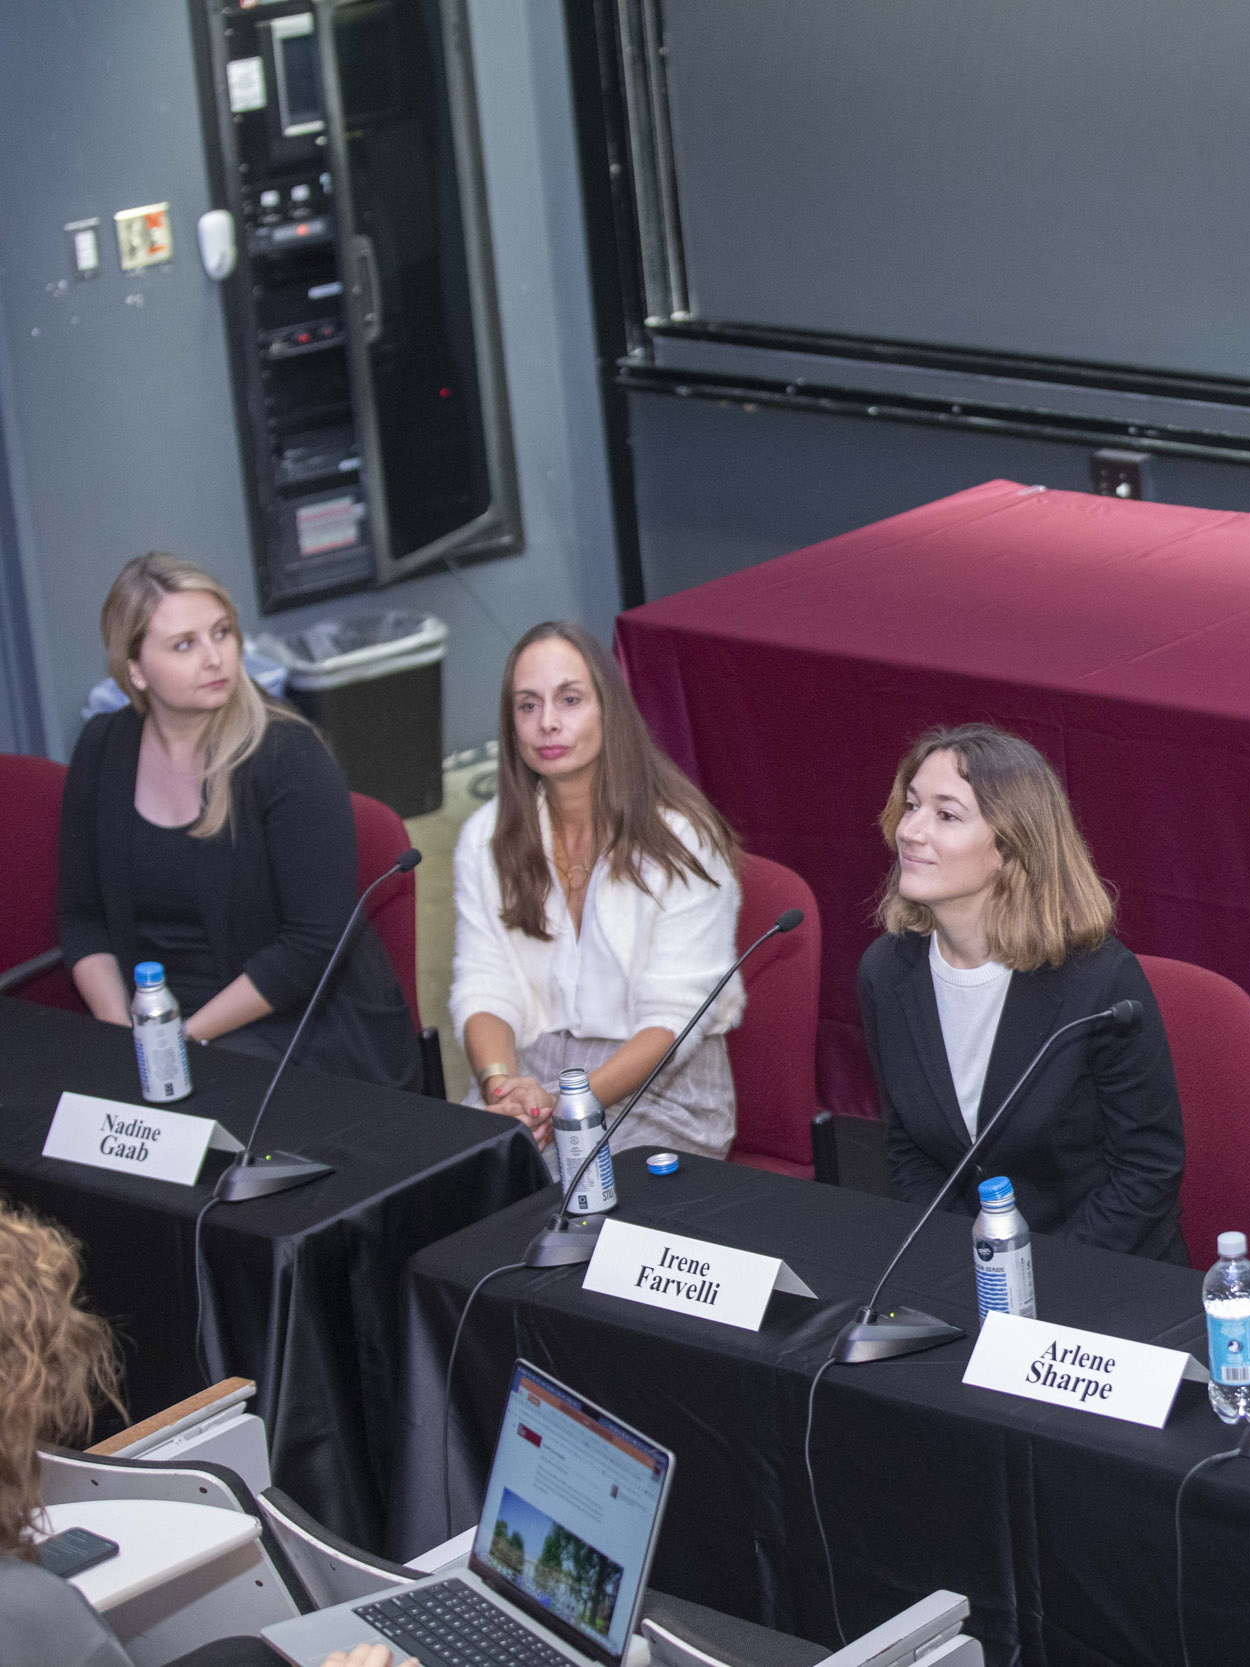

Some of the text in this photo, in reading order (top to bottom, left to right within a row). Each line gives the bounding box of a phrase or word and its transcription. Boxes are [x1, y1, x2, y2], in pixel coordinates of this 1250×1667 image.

[101, 1114, 161, 1142] Nadine
[99, 1134, 149, 1163] Gaab
[659, 1245, 711, 1279] Irene
[633, 1265, 720, 1306] Farvelli
[1040, 1341, 1115, 1374] Arlene
[1025, 1360, 1113, 1402] Sharpe
